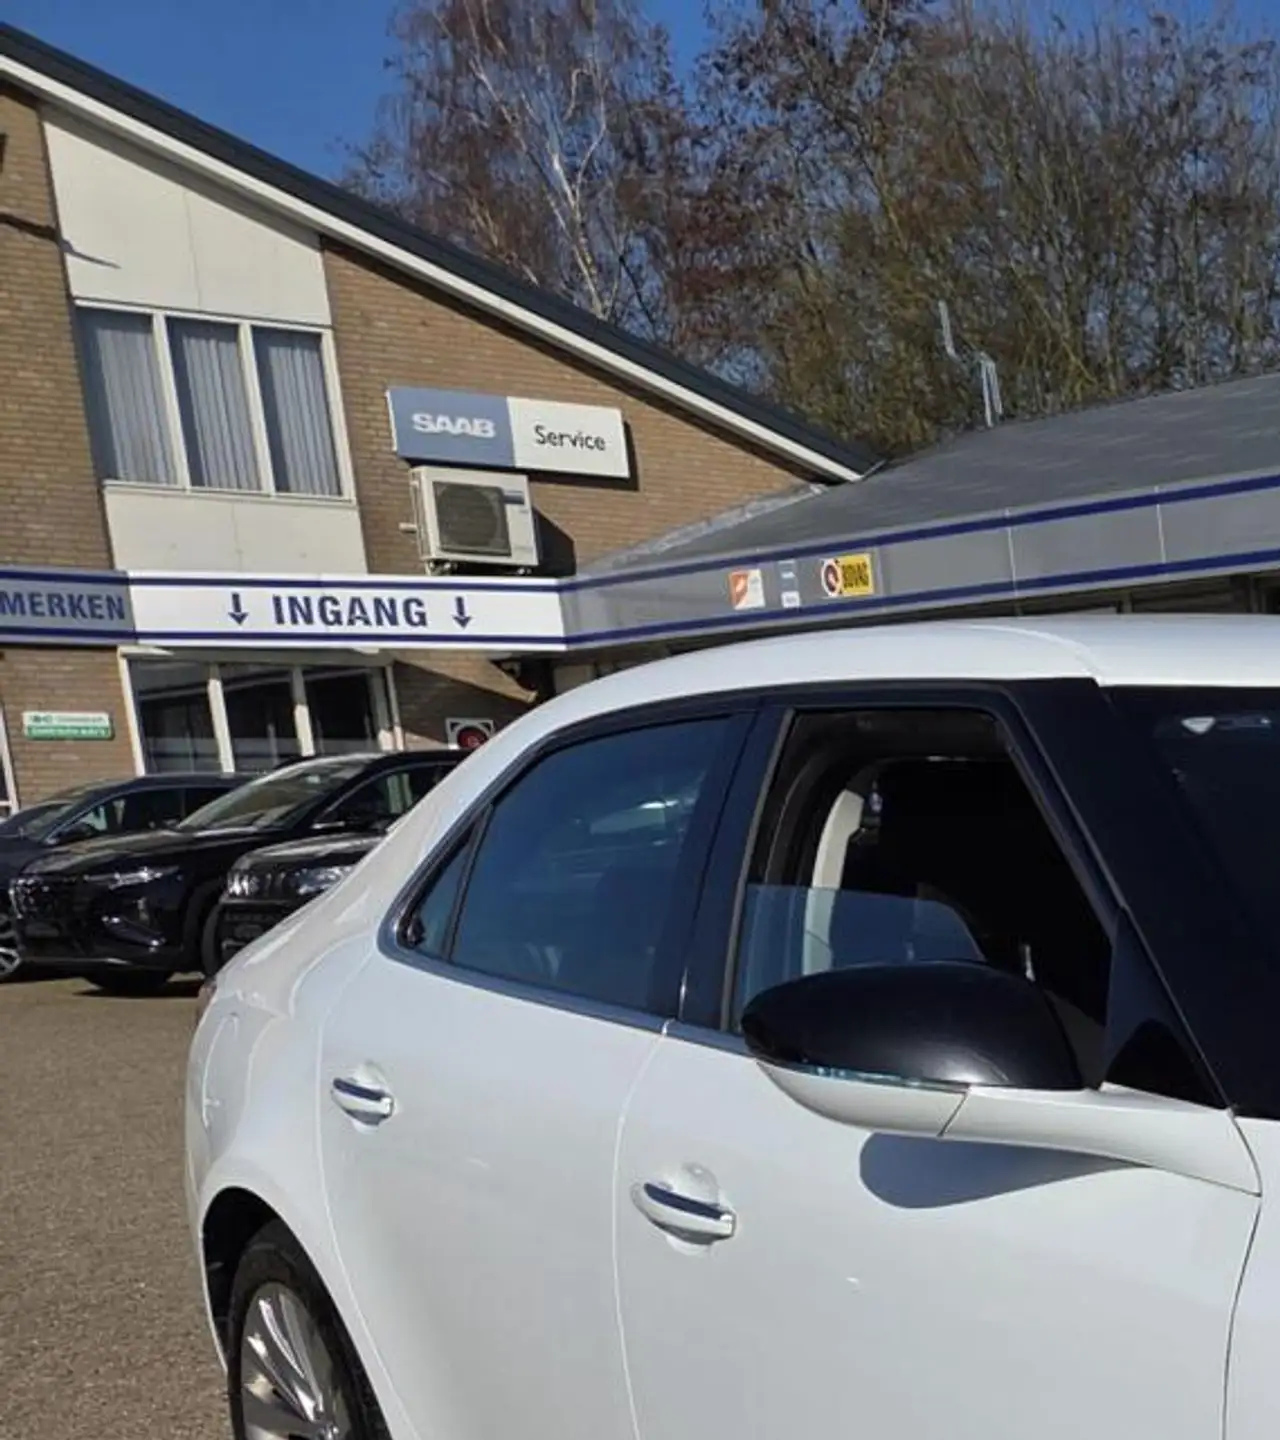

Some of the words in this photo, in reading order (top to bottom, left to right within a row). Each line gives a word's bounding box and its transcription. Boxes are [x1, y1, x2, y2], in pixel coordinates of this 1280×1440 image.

[412, 412, 496, 438] SAAB
[534, 424, 606, 452] Service
[0, 590, 126, 621] MERKEN
[272, 594, 428, 628] INGANG
